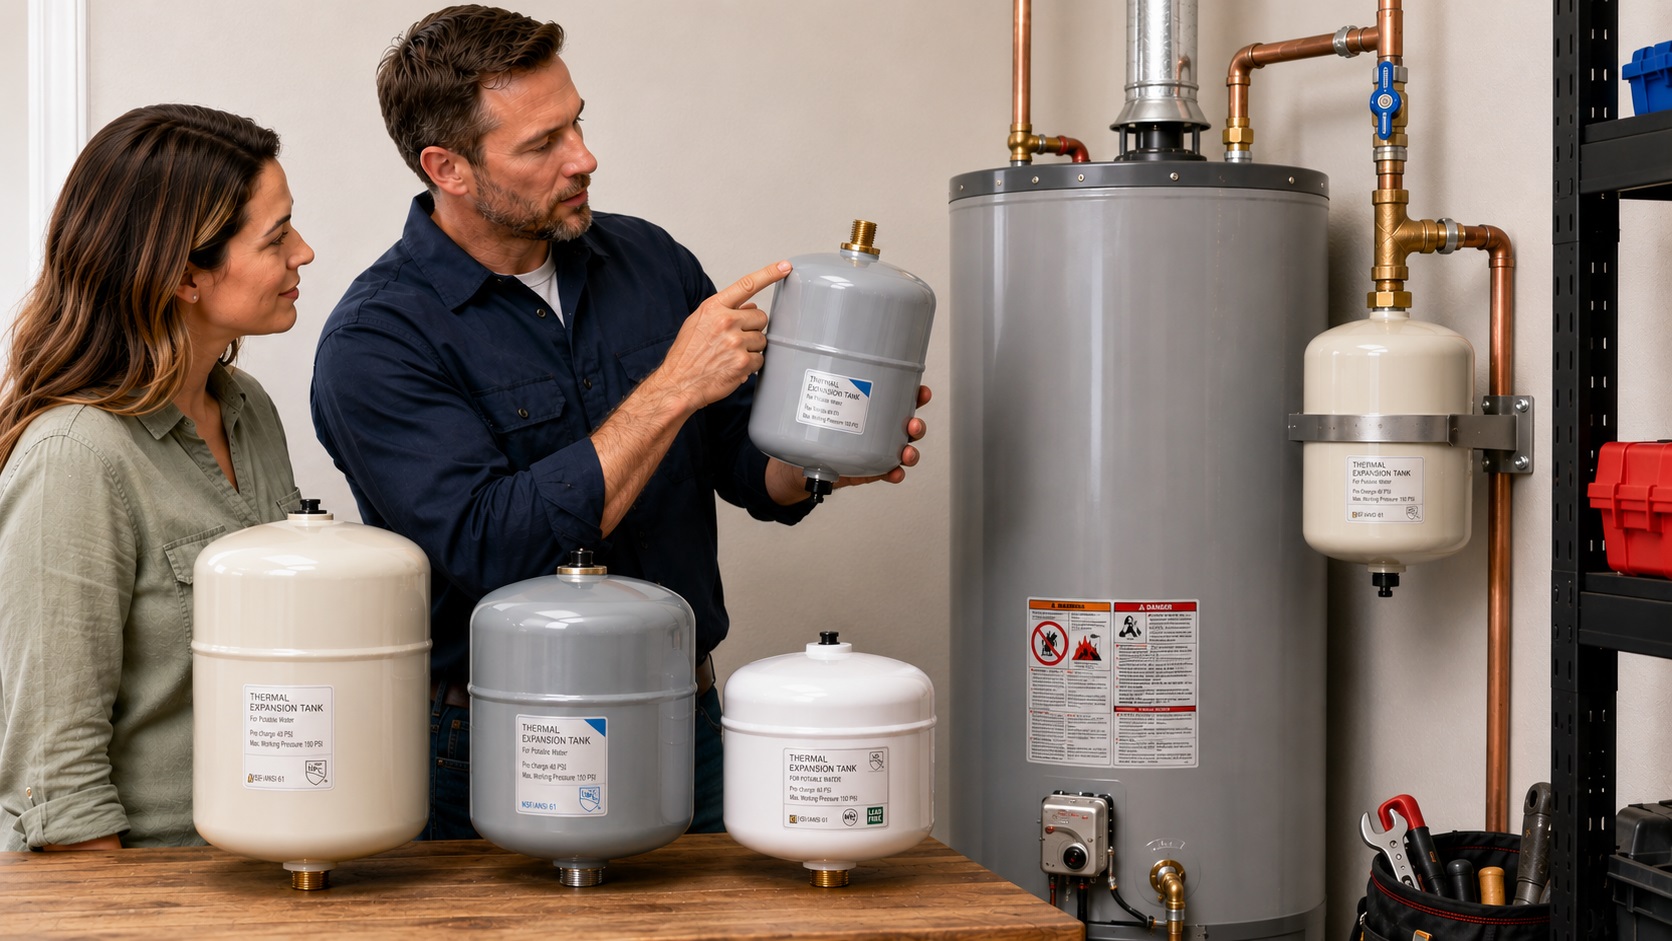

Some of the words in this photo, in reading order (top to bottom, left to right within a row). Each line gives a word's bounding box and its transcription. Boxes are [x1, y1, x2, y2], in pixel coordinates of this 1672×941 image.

[250, 693, 289, 702] THERMAL
[250, 703, 297, 712] EXPANSION
[522, 723, 560, 734] THERMAL
[522, 734, 566, 744] EXPANSION
[568, 736, 591, 744] TANK
[790, 754, 828, 763] THERMAL
[790, 764, 834, 772] EXPANSION
